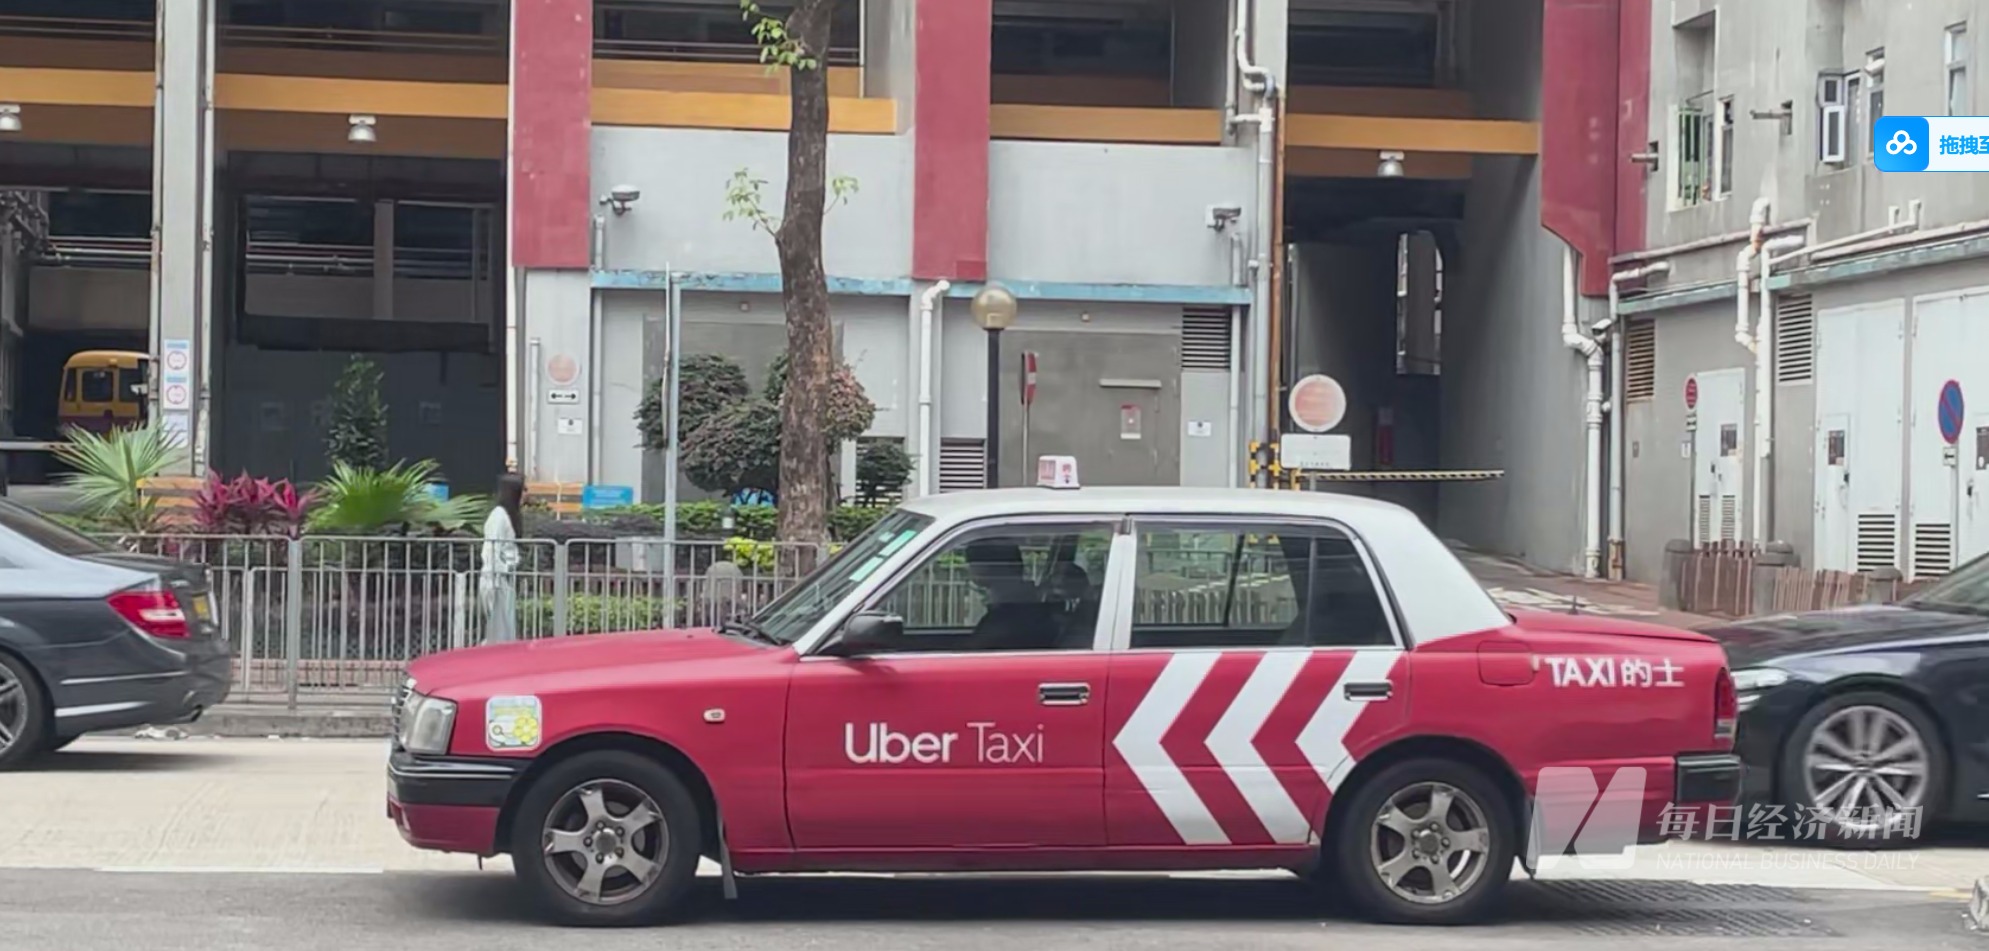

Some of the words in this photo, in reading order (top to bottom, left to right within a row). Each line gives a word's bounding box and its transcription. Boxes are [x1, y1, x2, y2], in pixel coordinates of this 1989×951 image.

[1544, 657, 1615, 687] TAXI
[1621, 657, 1685, 688] 的士
[845, 722, 958, 763] Uber
[967, 722, 1044, 763] Taxi
